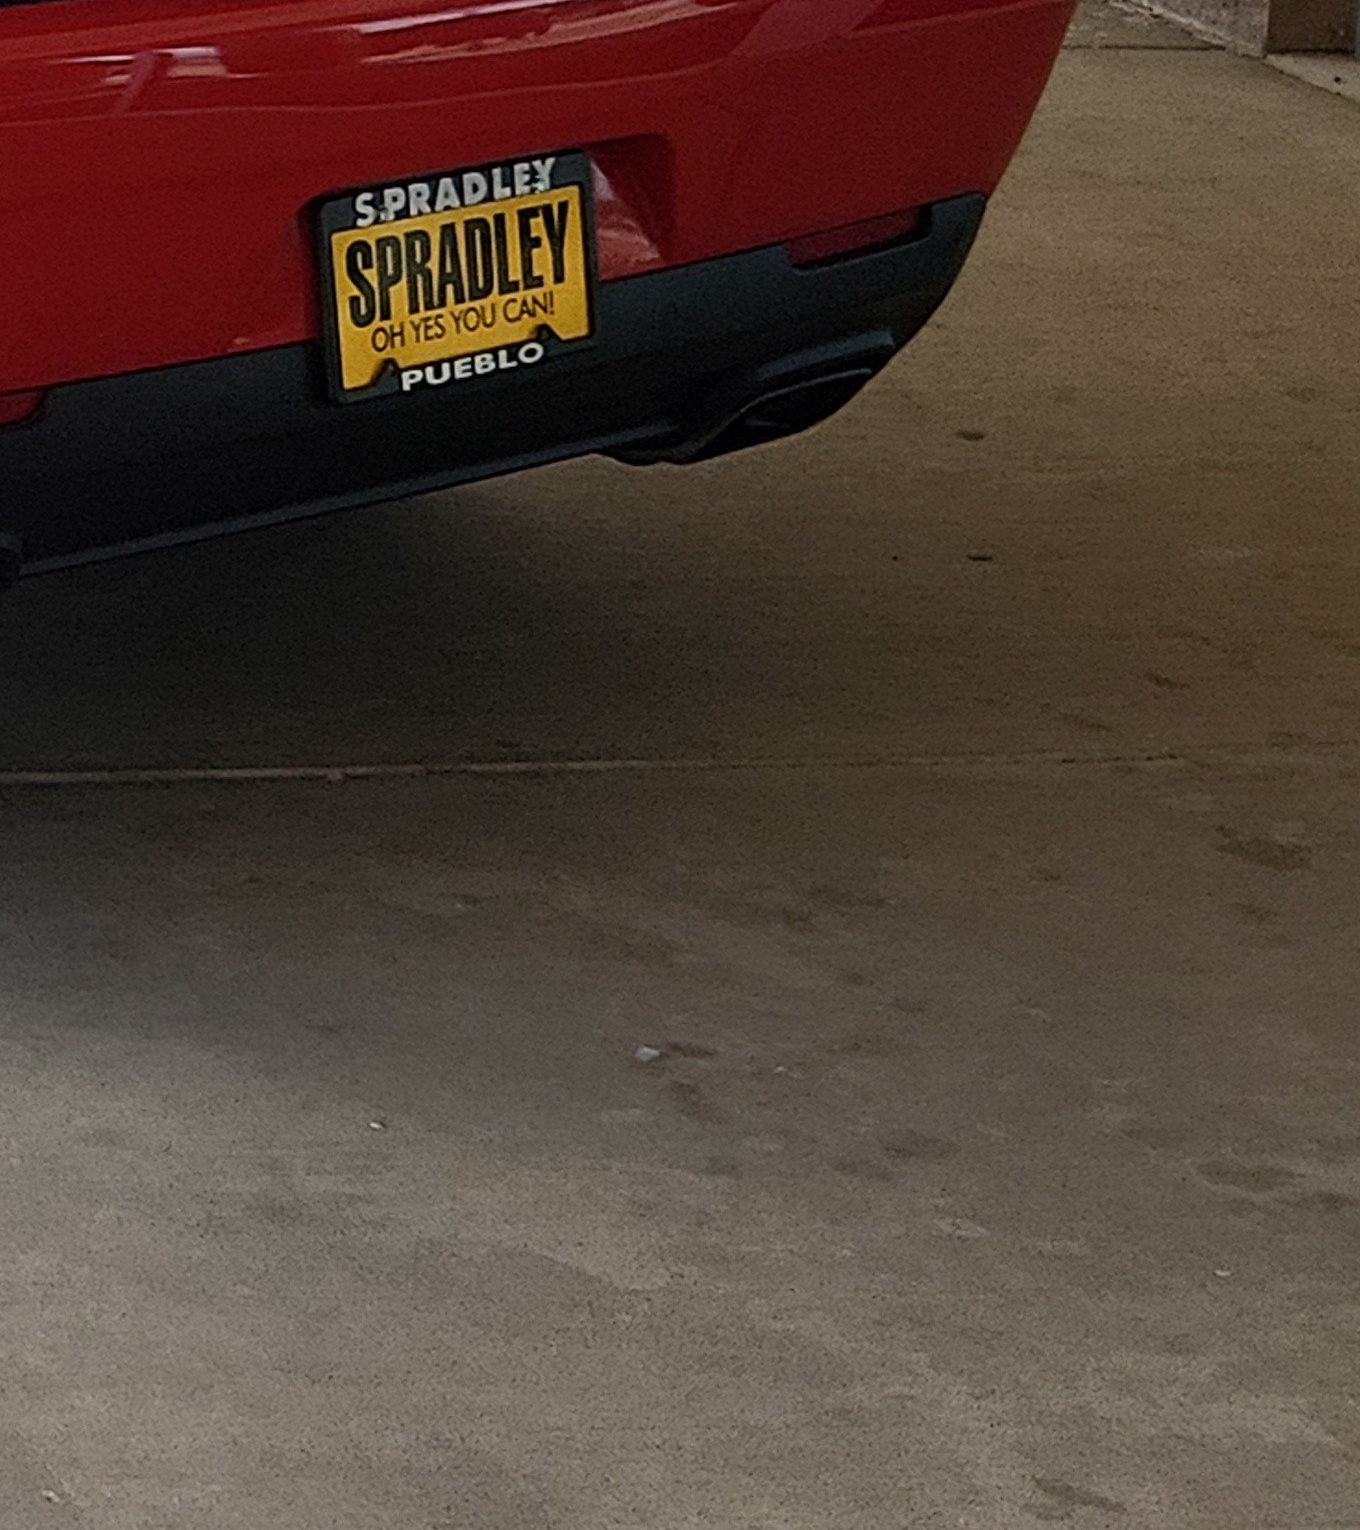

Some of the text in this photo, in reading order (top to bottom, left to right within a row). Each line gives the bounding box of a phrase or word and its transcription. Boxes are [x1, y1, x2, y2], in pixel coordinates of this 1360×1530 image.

[355, 157, 555, 227] SPRADLEY
[346, 201, 570, 328] SPRADLEY
[372, 290, 555, 353] OH YES YOU CAN!
[401, 343, 544, 391] PUEBLO
